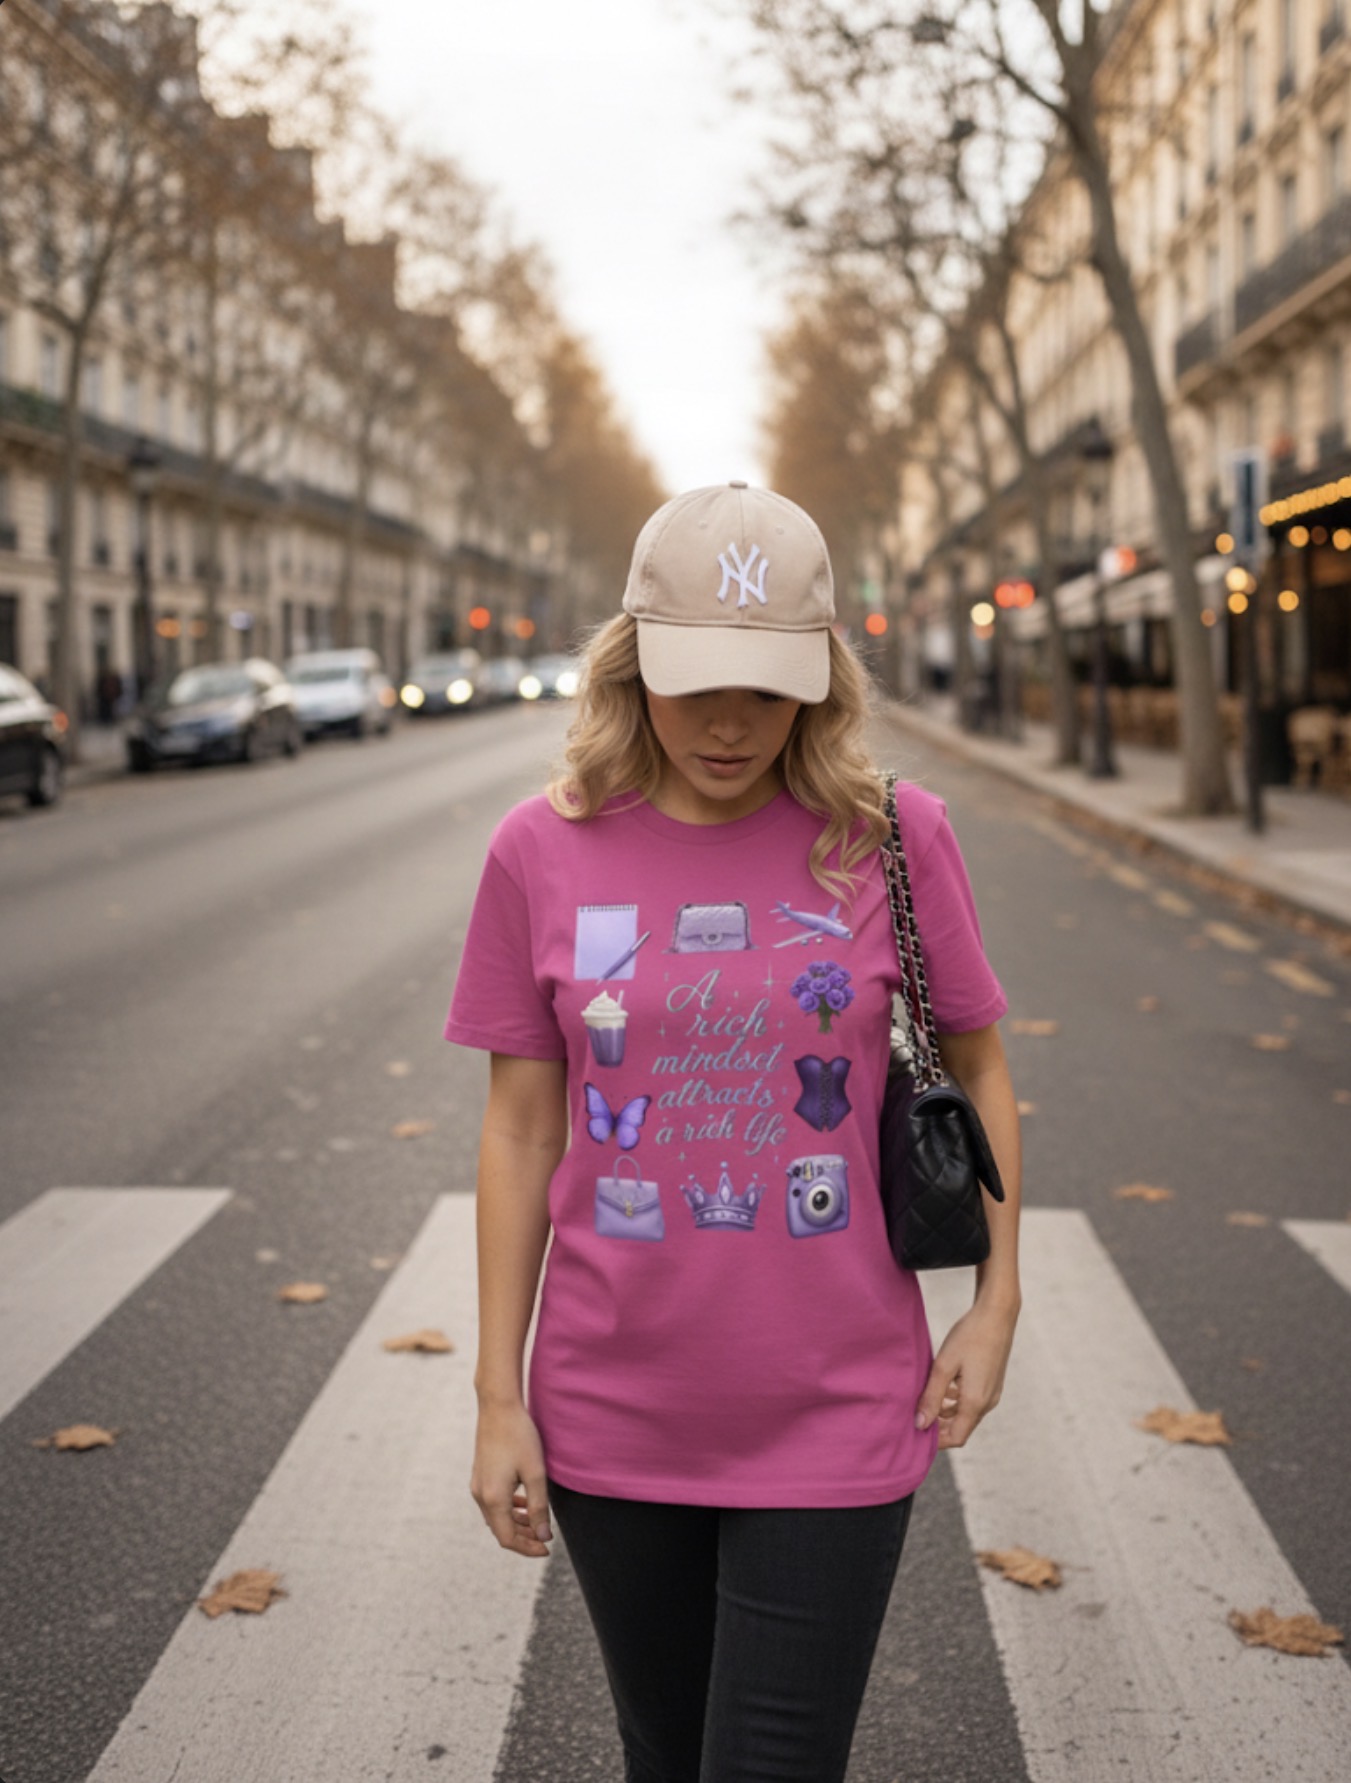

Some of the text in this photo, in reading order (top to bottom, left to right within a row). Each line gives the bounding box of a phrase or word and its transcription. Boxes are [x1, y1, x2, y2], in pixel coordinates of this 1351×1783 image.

[717, 542, 769, 608] NY
[666, 969, 720, 1013] A
[685, 998, 770, 1037] rich
[651, 1035, 784, 1075] mindset
[657, 1078, 774, 1110] attracts
[655, 1108, 787, 1157] a rich life
